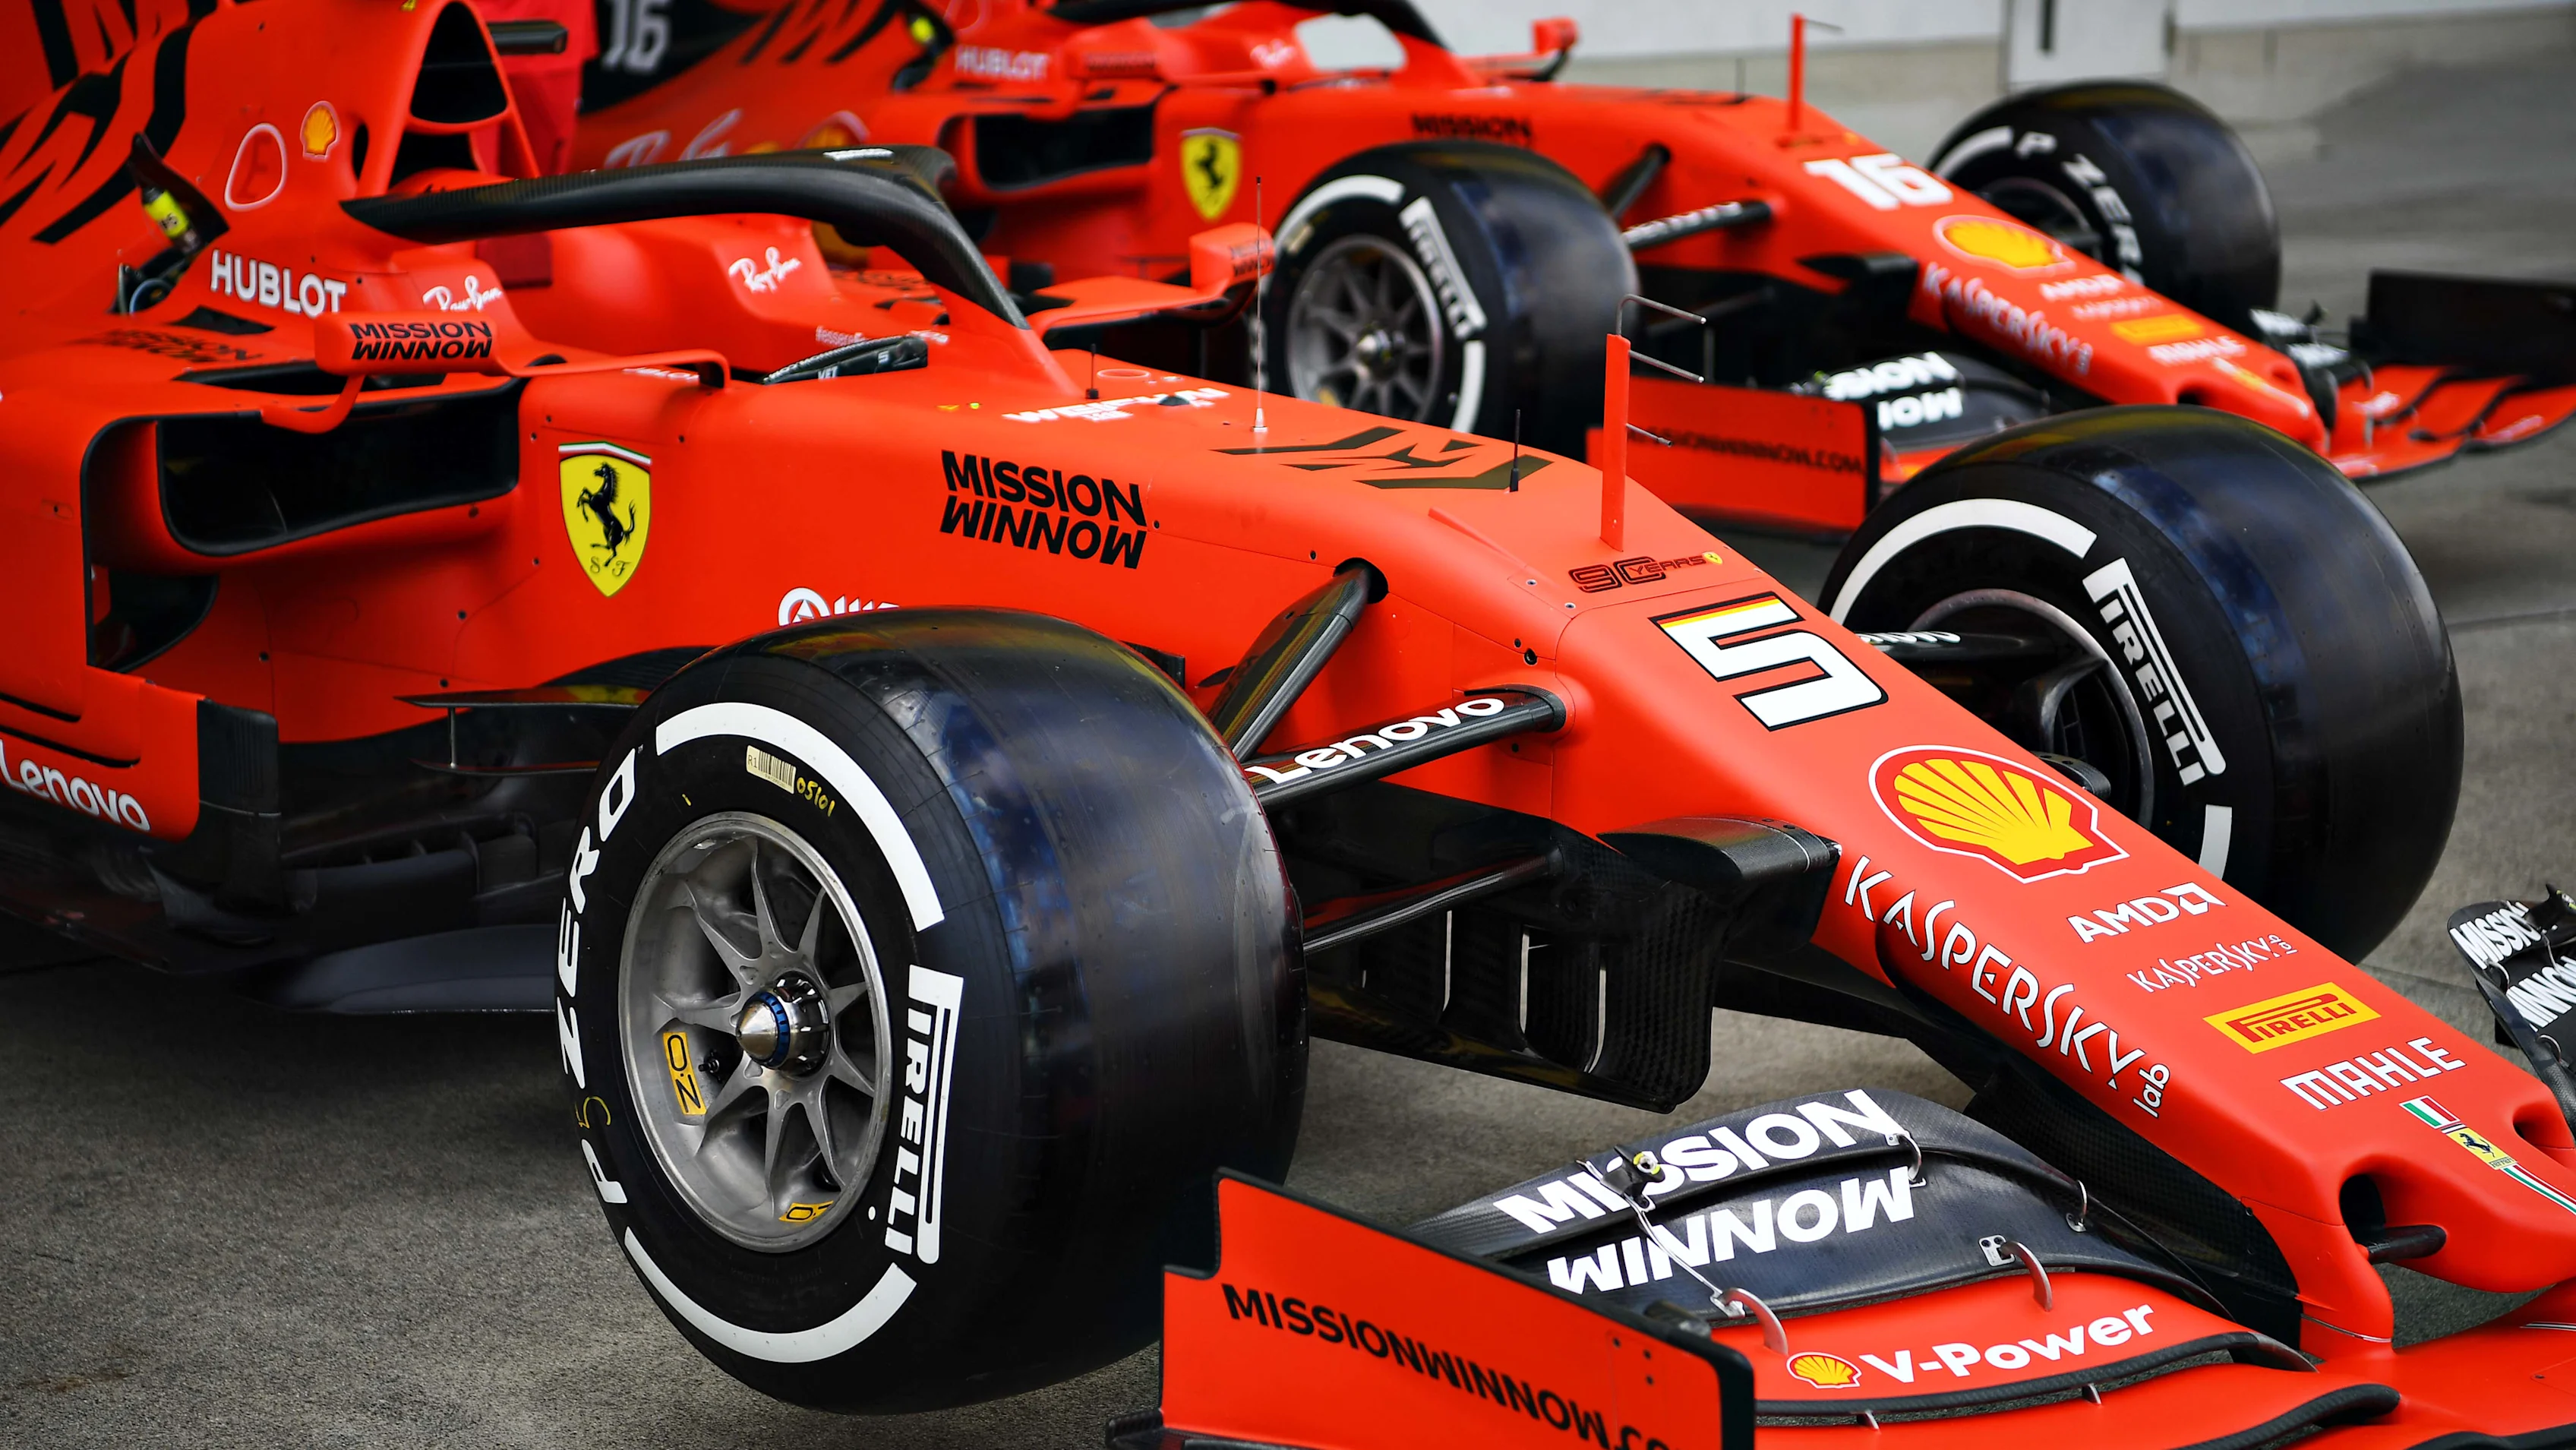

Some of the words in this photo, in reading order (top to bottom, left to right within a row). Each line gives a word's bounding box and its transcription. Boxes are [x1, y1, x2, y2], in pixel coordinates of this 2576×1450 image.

[1804, 152, 1953, 211] 16
[210, 248, 347, 319] HUBLOT
[349, 321, 493, 340] MISSION
[351, 339, 493, 360] WINNOW
[940, 450, 1148, 527] MISSION
[939, 494, 1148, 570] WINNOW
[1628, 554, 1707, 576] YEARS
[1646, 590, 1889, 732] 5
[2082, 557, 2227, 787] PIRELLI
[1244, 697, 1505, 785] Lenovo
[0, 738, 150, 831] Lenovo
[557, 747, 636, 1089] ZERO
[2066, 896, 2181, 943] AMD
[1844, 855, 2148, 1091] KASPERSKY
[2132, 1063, 2170, 1118] lab
[2125, 936, 2281, 993] KASPERSKY
[2225, 993, 2357, 1043] PIRELLI
[2279, 1036, 2467, 1111] MAHLE
[885, 964, 964, 1265] PIRELLI
[1546, 1166, 1915, 1295] WINNOW
[1859, 1303, 2155, 1383] V-Power
